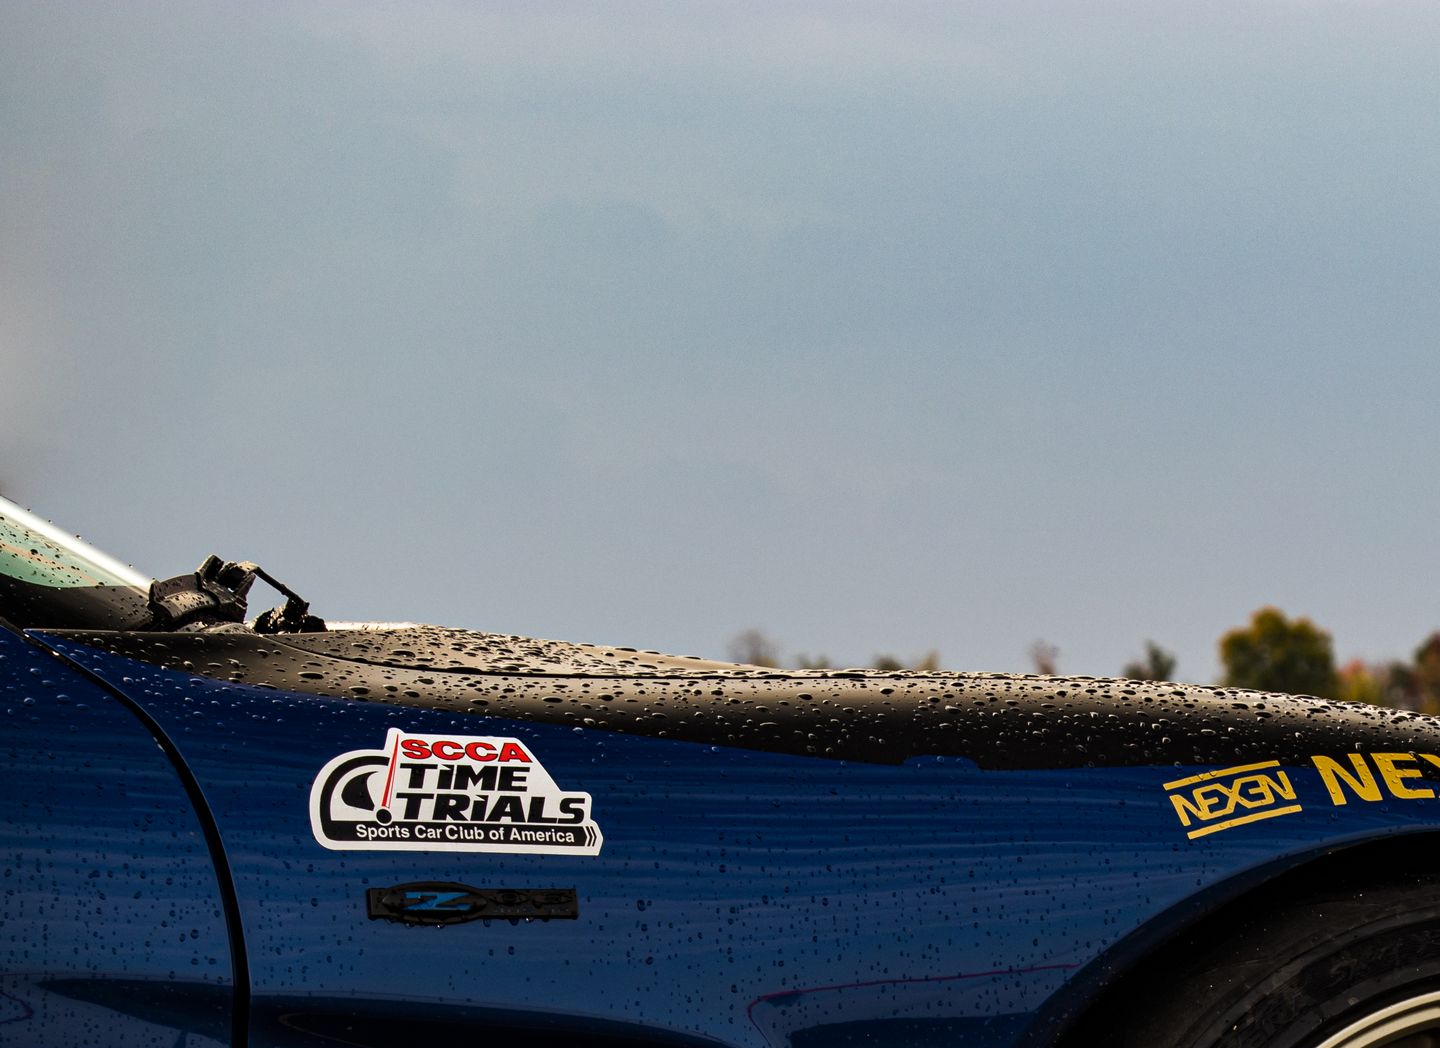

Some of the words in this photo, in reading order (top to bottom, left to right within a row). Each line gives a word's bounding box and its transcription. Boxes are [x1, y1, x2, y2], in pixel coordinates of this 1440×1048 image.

[400, 738, 533, 763] SCCA
[400, 762, 531, 792] TIME
[396, 792, 586, 825] TRIALS
[1169, 770, 1295, 827] NEXEN
[356, 824, 410, 841] Sports
[414, 825, 443, 839] Car
[445, 825, 485, 840] Club
[489, 826, 505, 841] of
[510, 827, 576, 843] America
